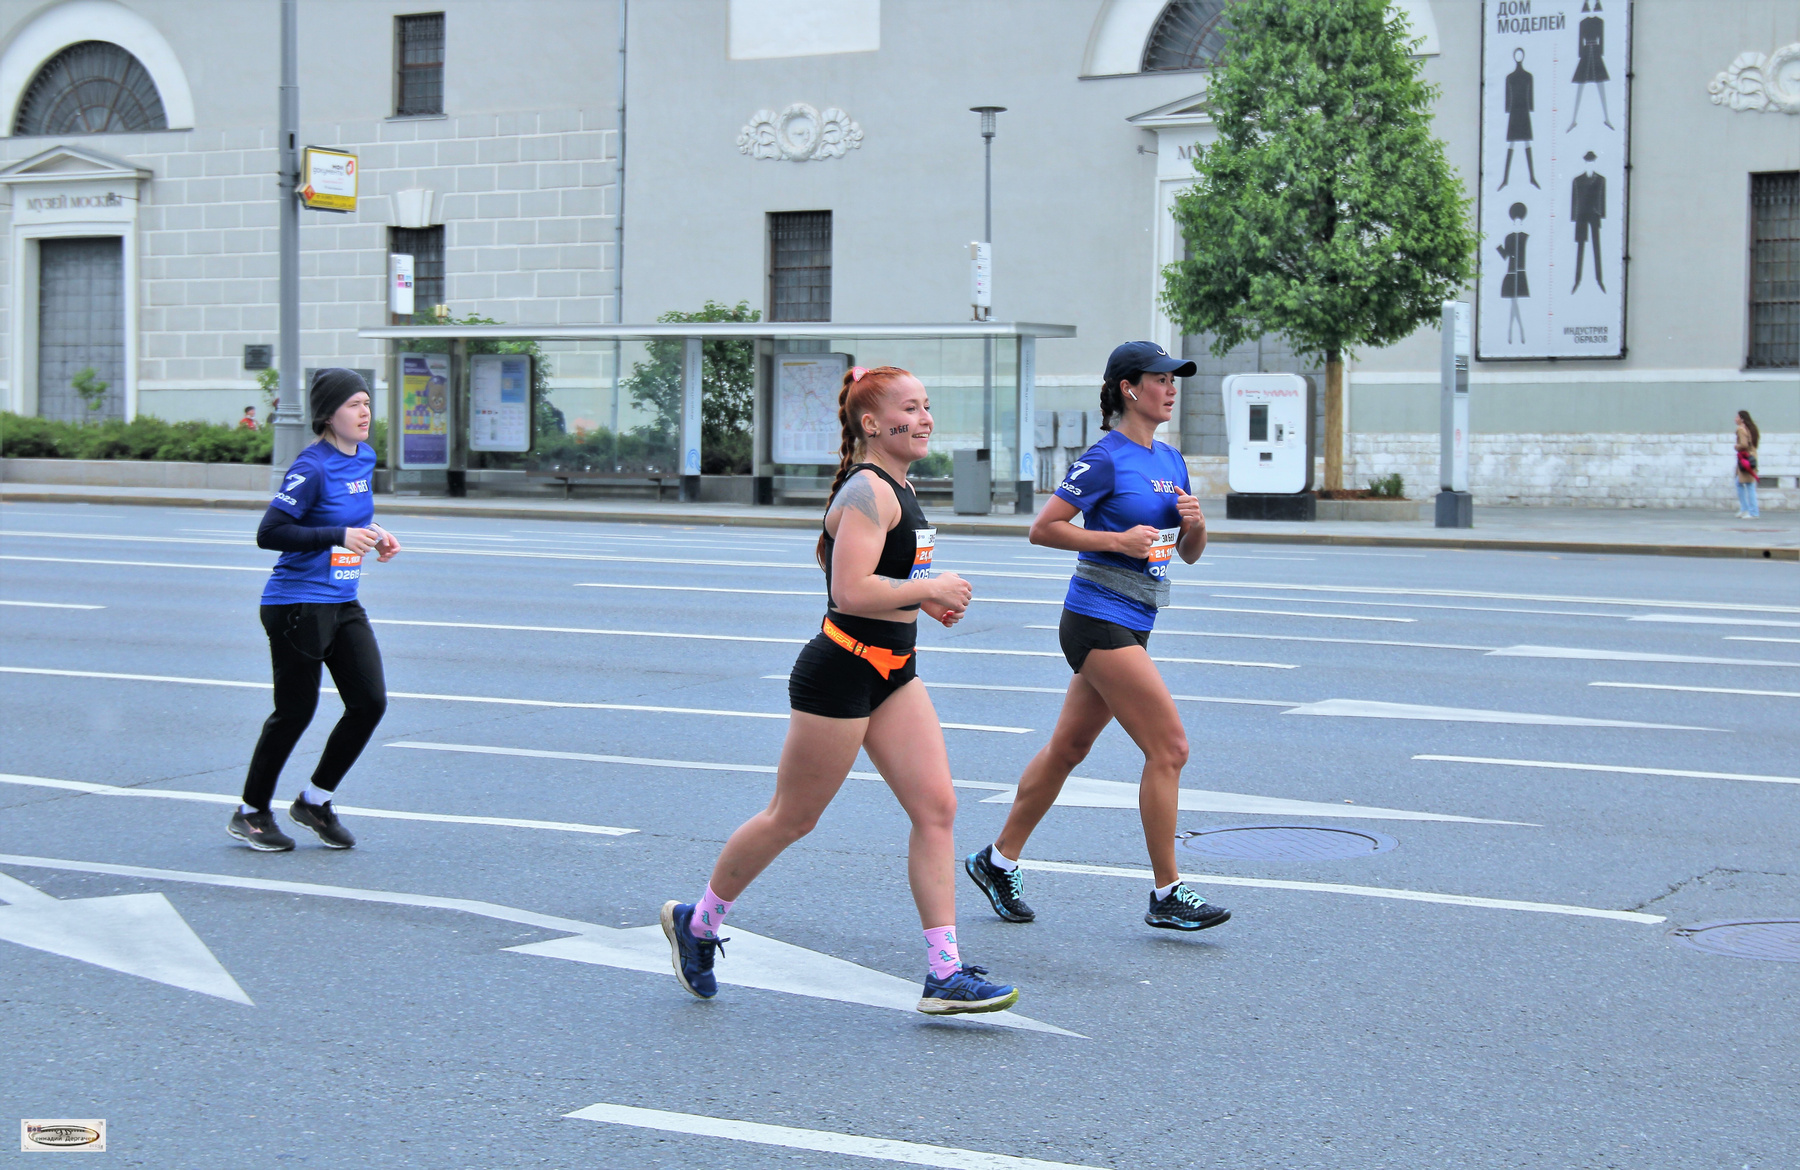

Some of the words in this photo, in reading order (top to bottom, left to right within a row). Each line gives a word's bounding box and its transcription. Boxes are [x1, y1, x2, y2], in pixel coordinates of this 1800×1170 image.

[1497, 1, 1531, 18] ДОМ
[1498, 12, 1565, 34] МОДЕЛЕЙ
[27, 194, 67, 213] МУЗЕЙ
[1563, 326, 1608, 336] ИНДУСТРИЯ
[1574, 335, 1608, 344] ОБРАЗОВ
[1071, 461, 1091, 481] 7
[286, 473, 306, 491] 7
